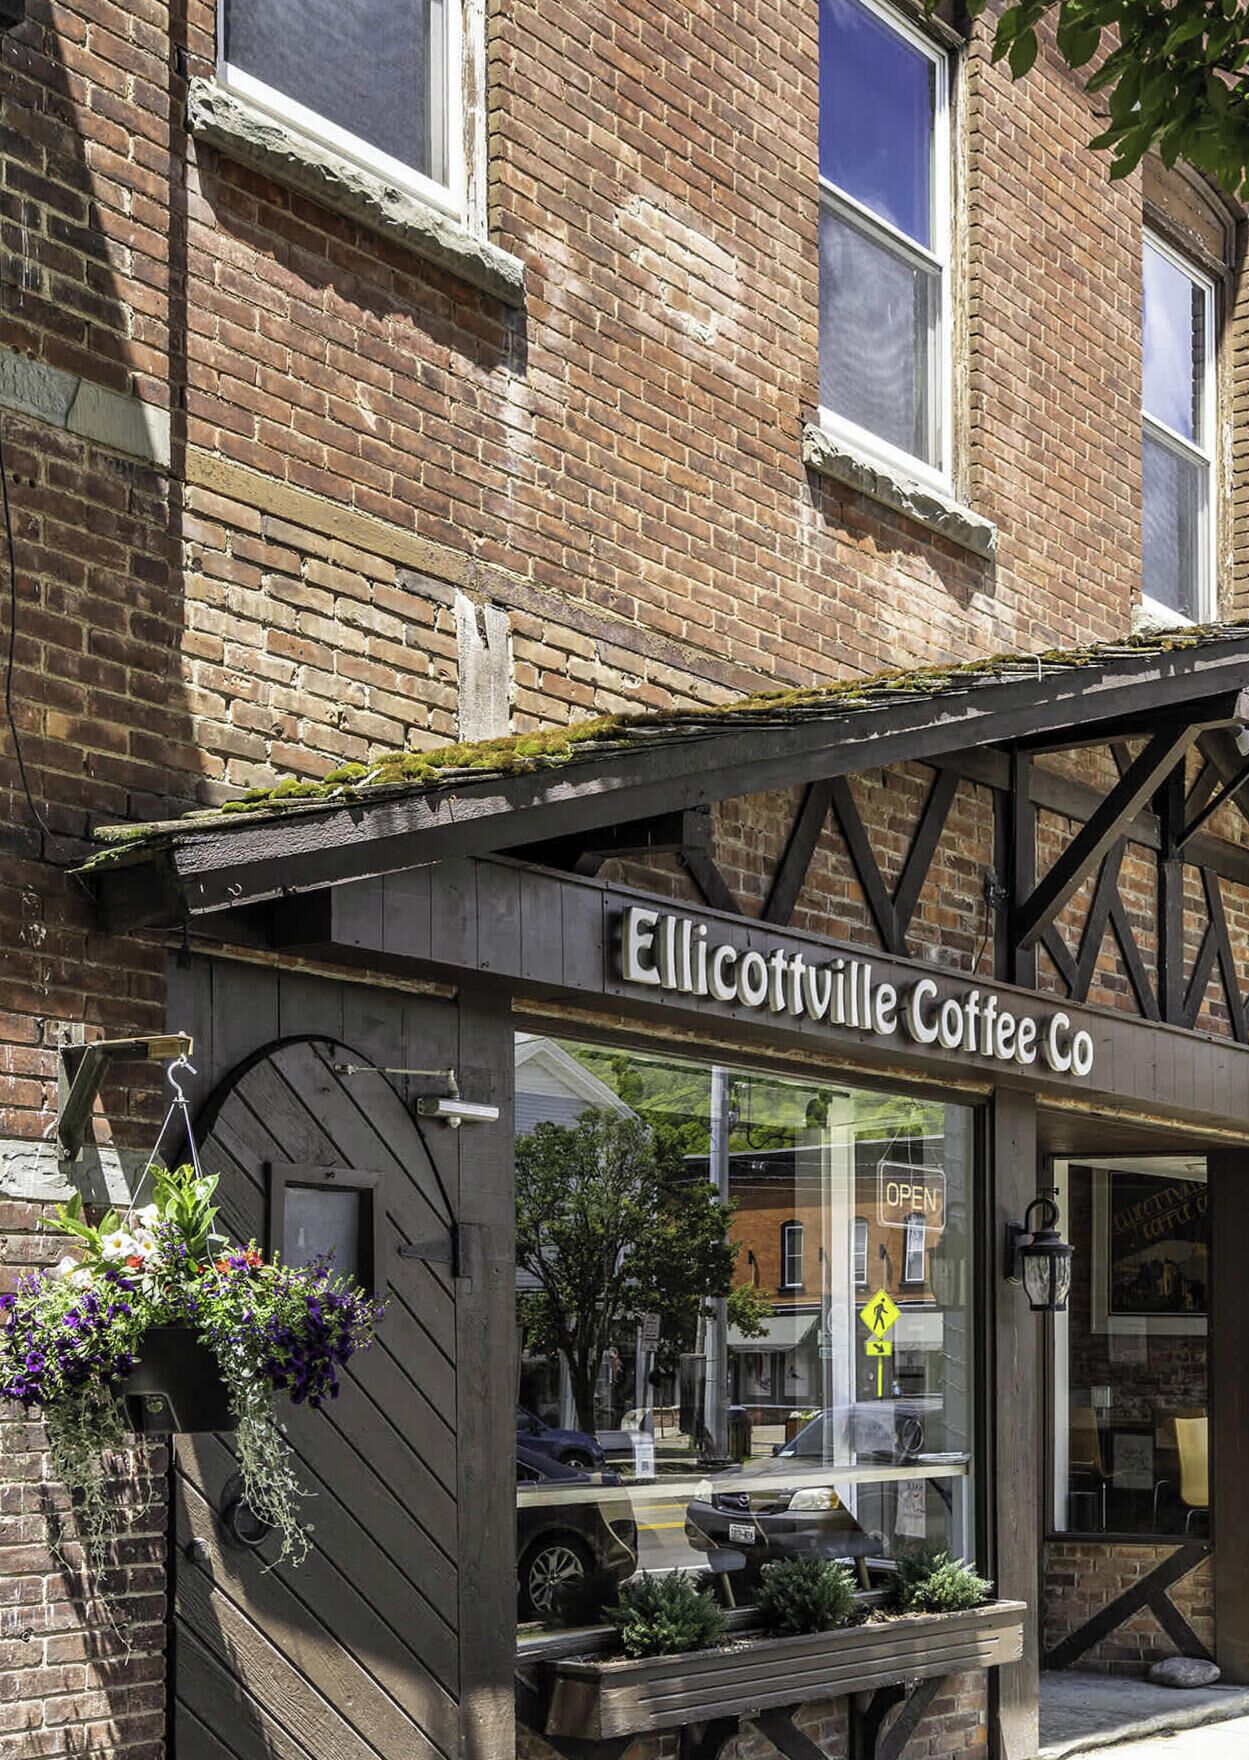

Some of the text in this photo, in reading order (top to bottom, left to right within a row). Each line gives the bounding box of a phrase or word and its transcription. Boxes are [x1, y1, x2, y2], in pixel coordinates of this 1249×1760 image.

[622, 906, 1094, 1076] Ellicottville Coffee Co
[887, 1182, 937, 1211] OPEN
